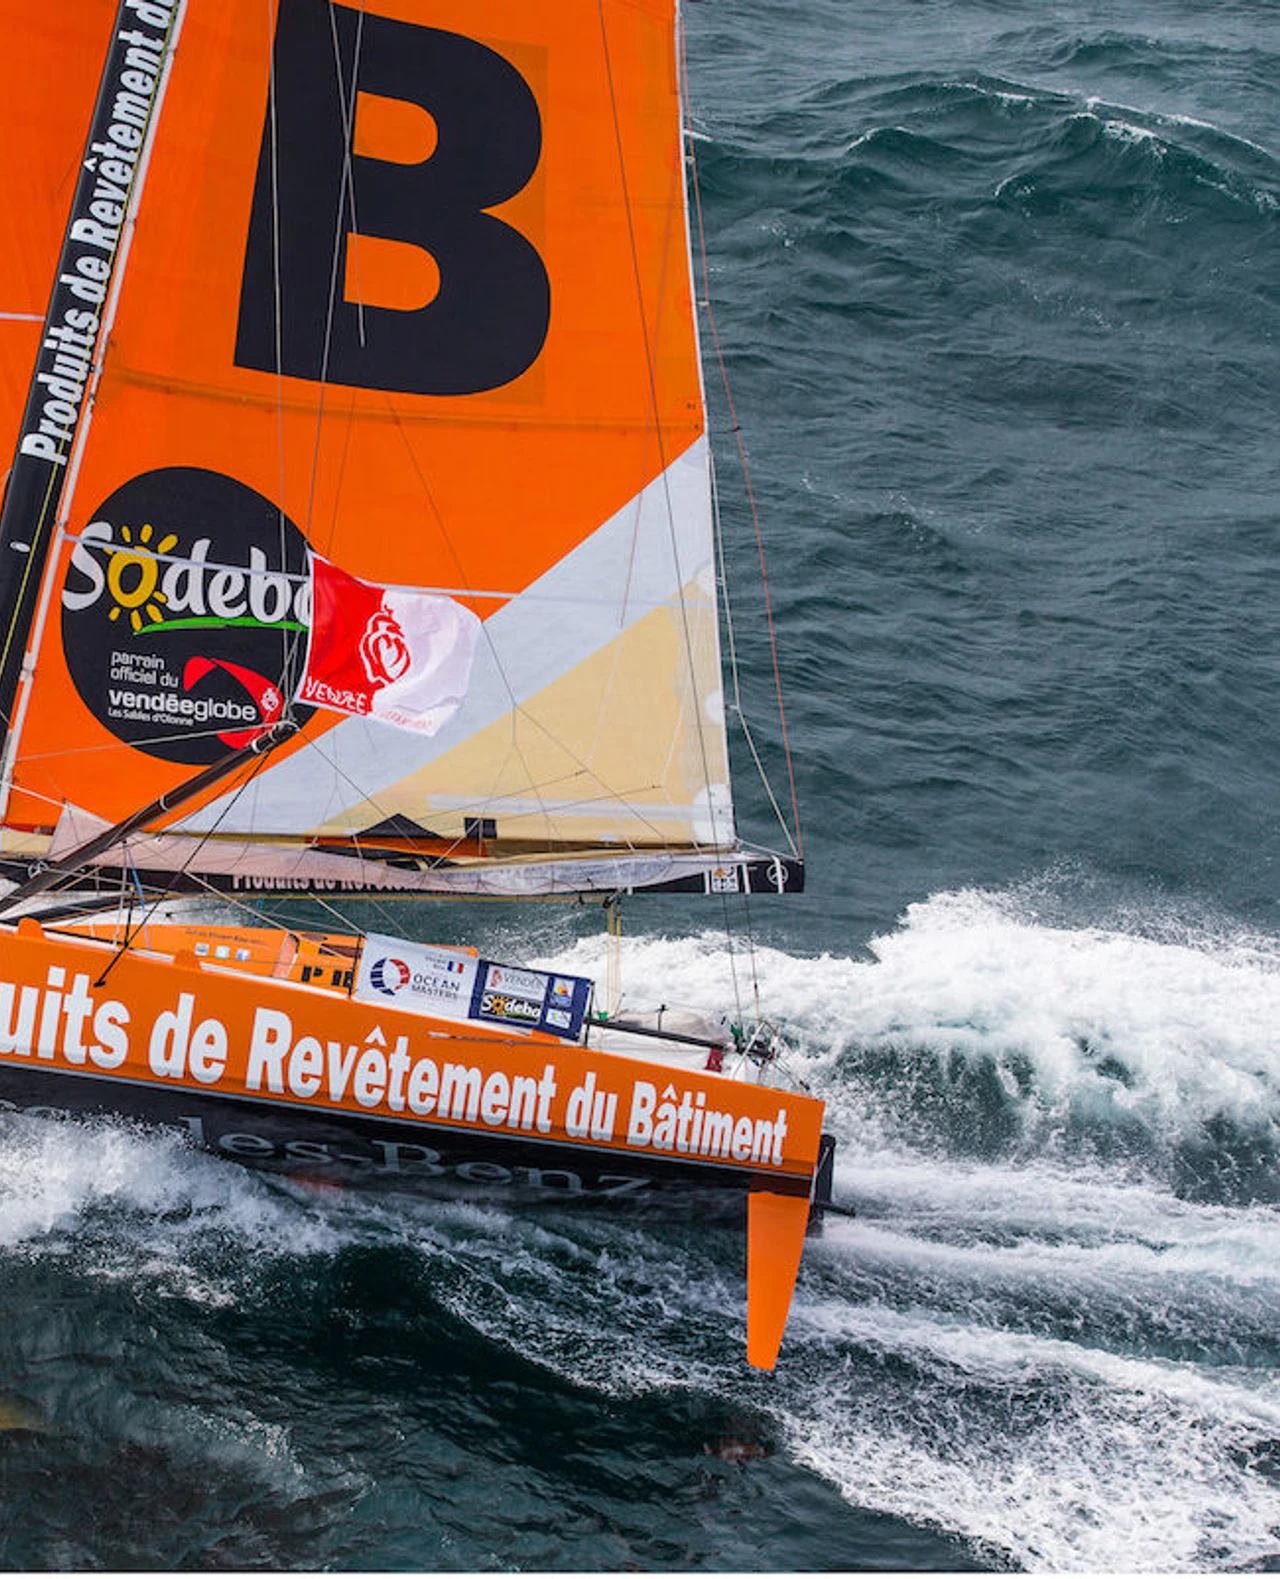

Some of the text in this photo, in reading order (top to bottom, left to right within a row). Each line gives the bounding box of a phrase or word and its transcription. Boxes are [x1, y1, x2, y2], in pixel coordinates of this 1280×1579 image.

[70, 30, 165, 252] Revêtement
[233, 0, 551, 396] B
[59, 255, 111, 304] de
[20, 308, 100, 466] Produits
[110, 666, 179, 688] officiel du
[111, 651, 165, 670] parrain
[411, 984, 459, 999] MASTERS
[413, 973, 461, 992] OCEAN
[481, 994, 542, 1018] Sodebo
[148, 992, 228, 1085] de
[245, 1007, 557, 1134] Revêtement
[566, 1072, 619, 1142] du
[626, 1080, 788, 1166] Bâtiment
